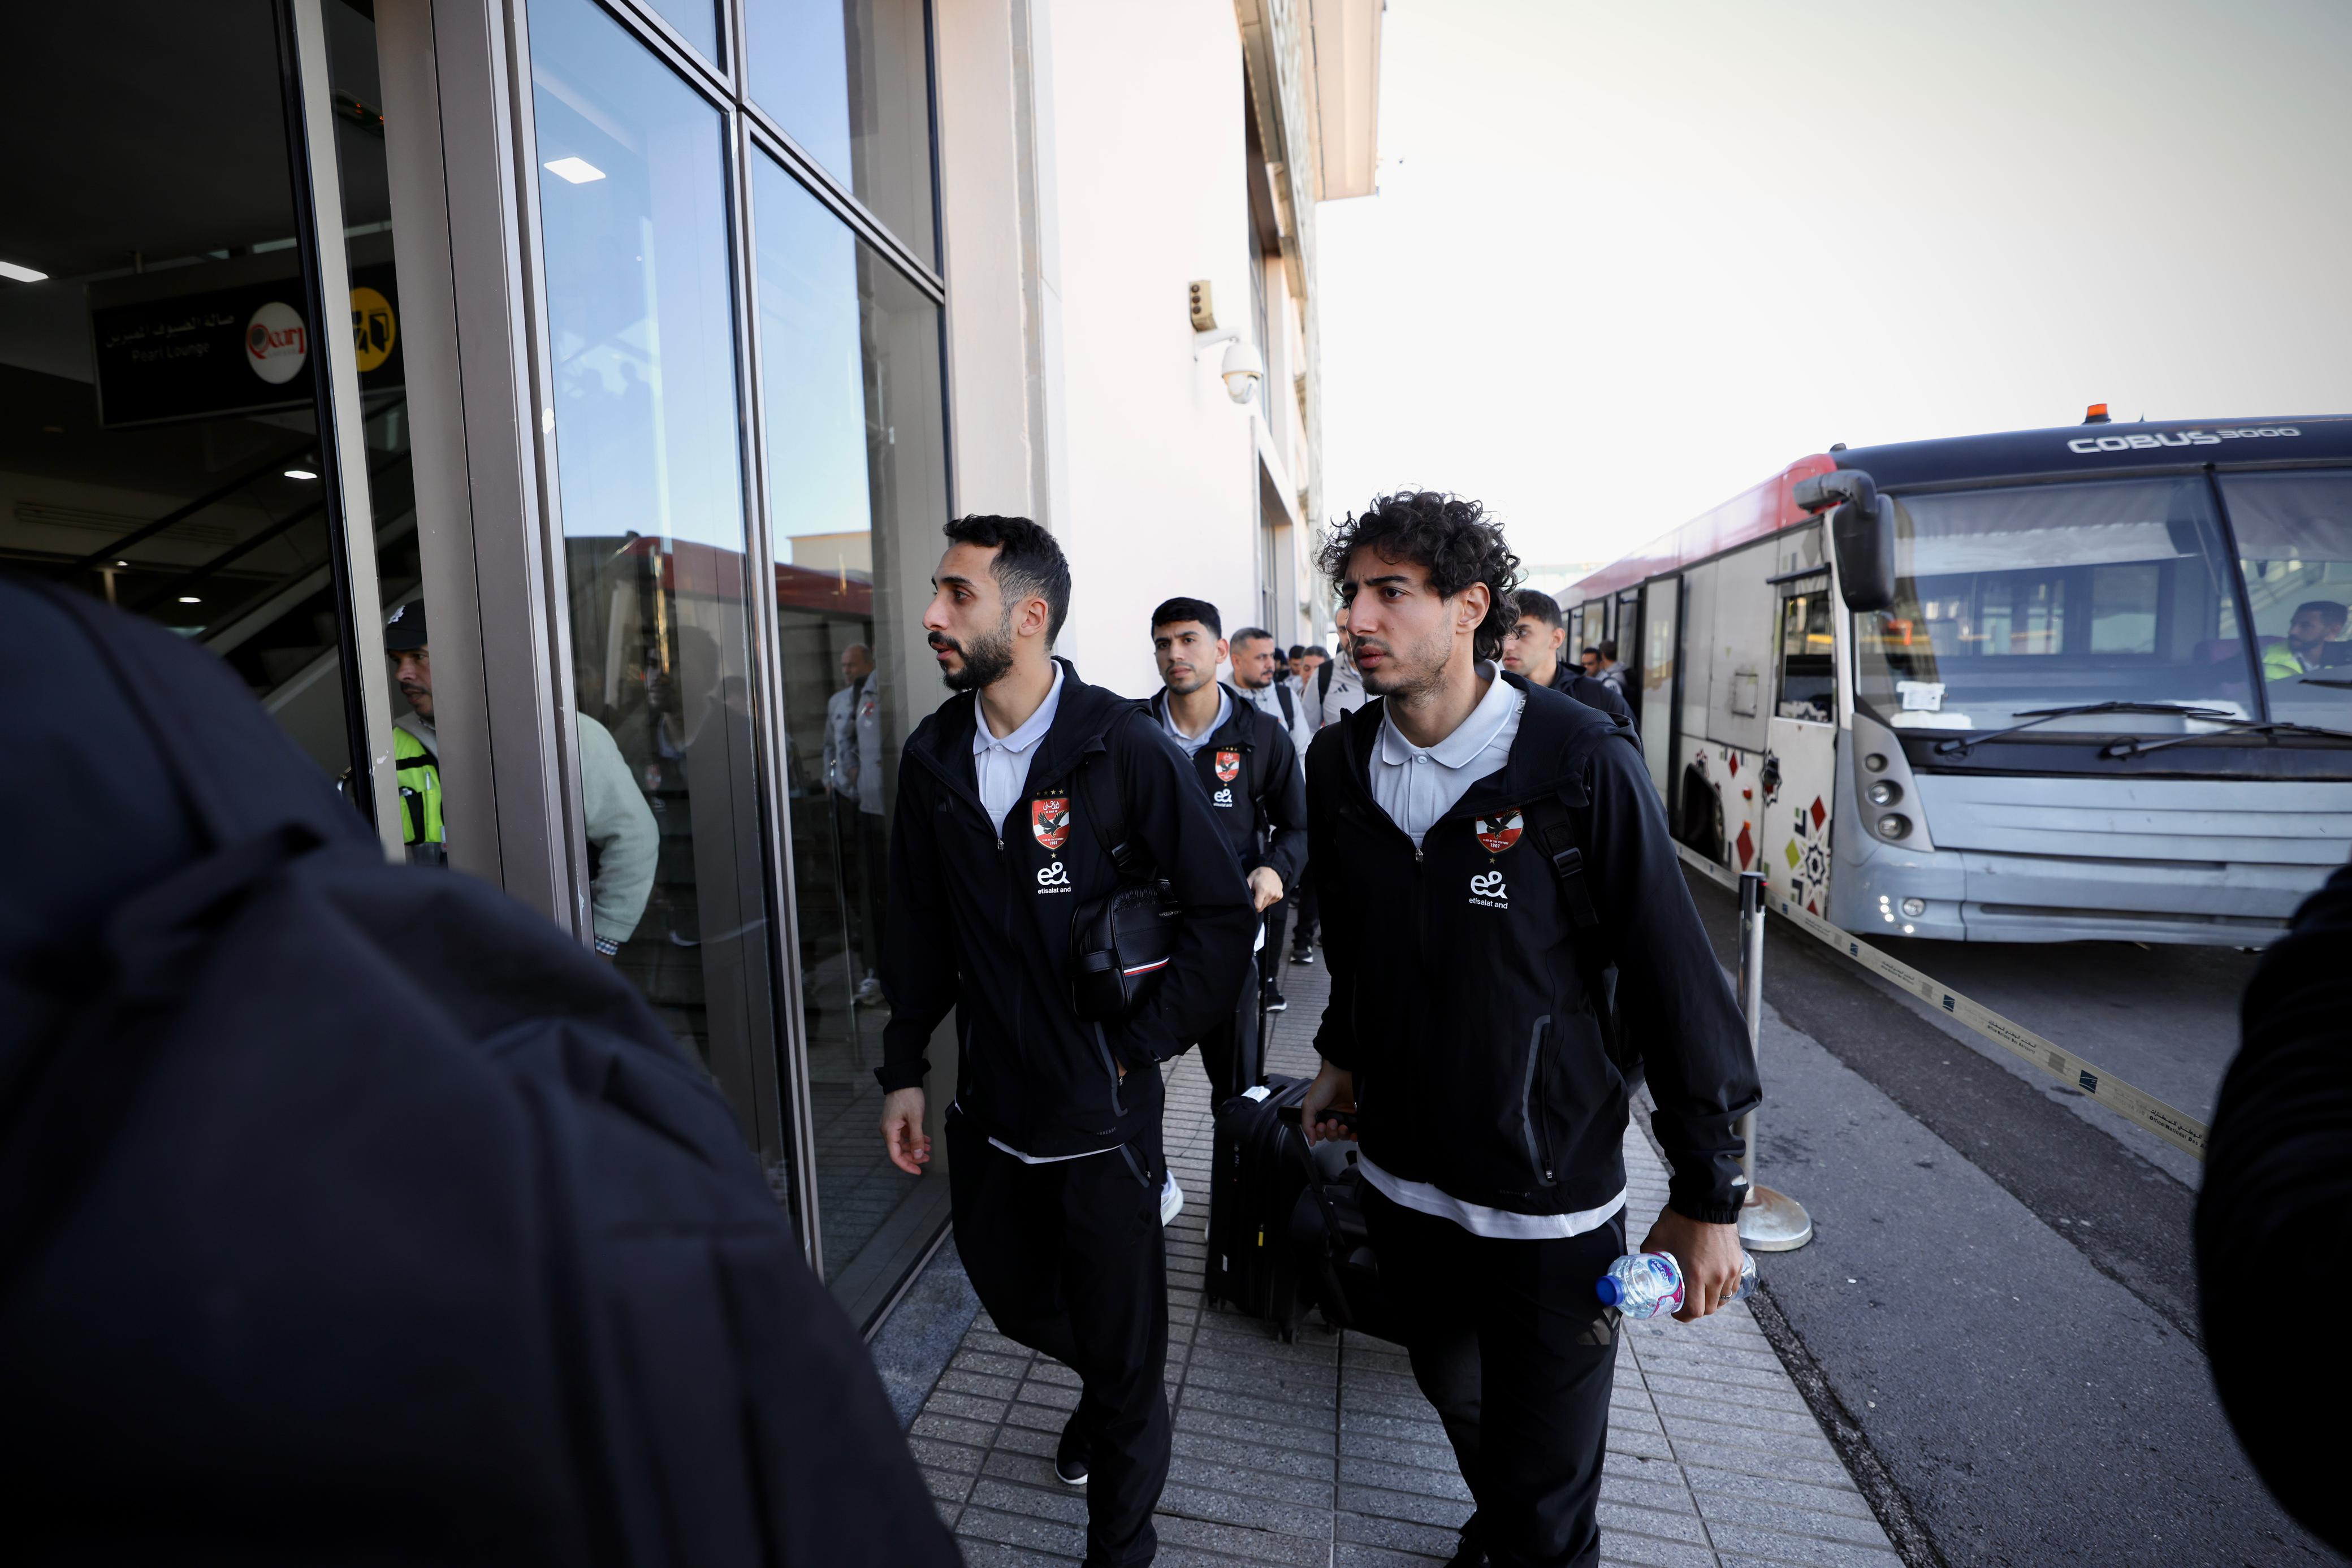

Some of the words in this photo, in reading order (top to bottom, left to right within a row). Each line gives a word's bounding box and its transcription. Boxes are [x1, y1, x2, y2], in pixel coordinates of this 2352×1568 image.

[131, 346, 166, 364] Pearl
[166, 342, 210, 359] Lounge
[2067, 431, 2222, 453] COBUS
[2217, 427, 2301, 439] 3000
[1469, 897, 1493, 907] etisalat
[2149, 1115, 2164, 1127] Office
[2165, 1124, 2187, 1140] National
[2188, 1136, 2198, 1146] Des
